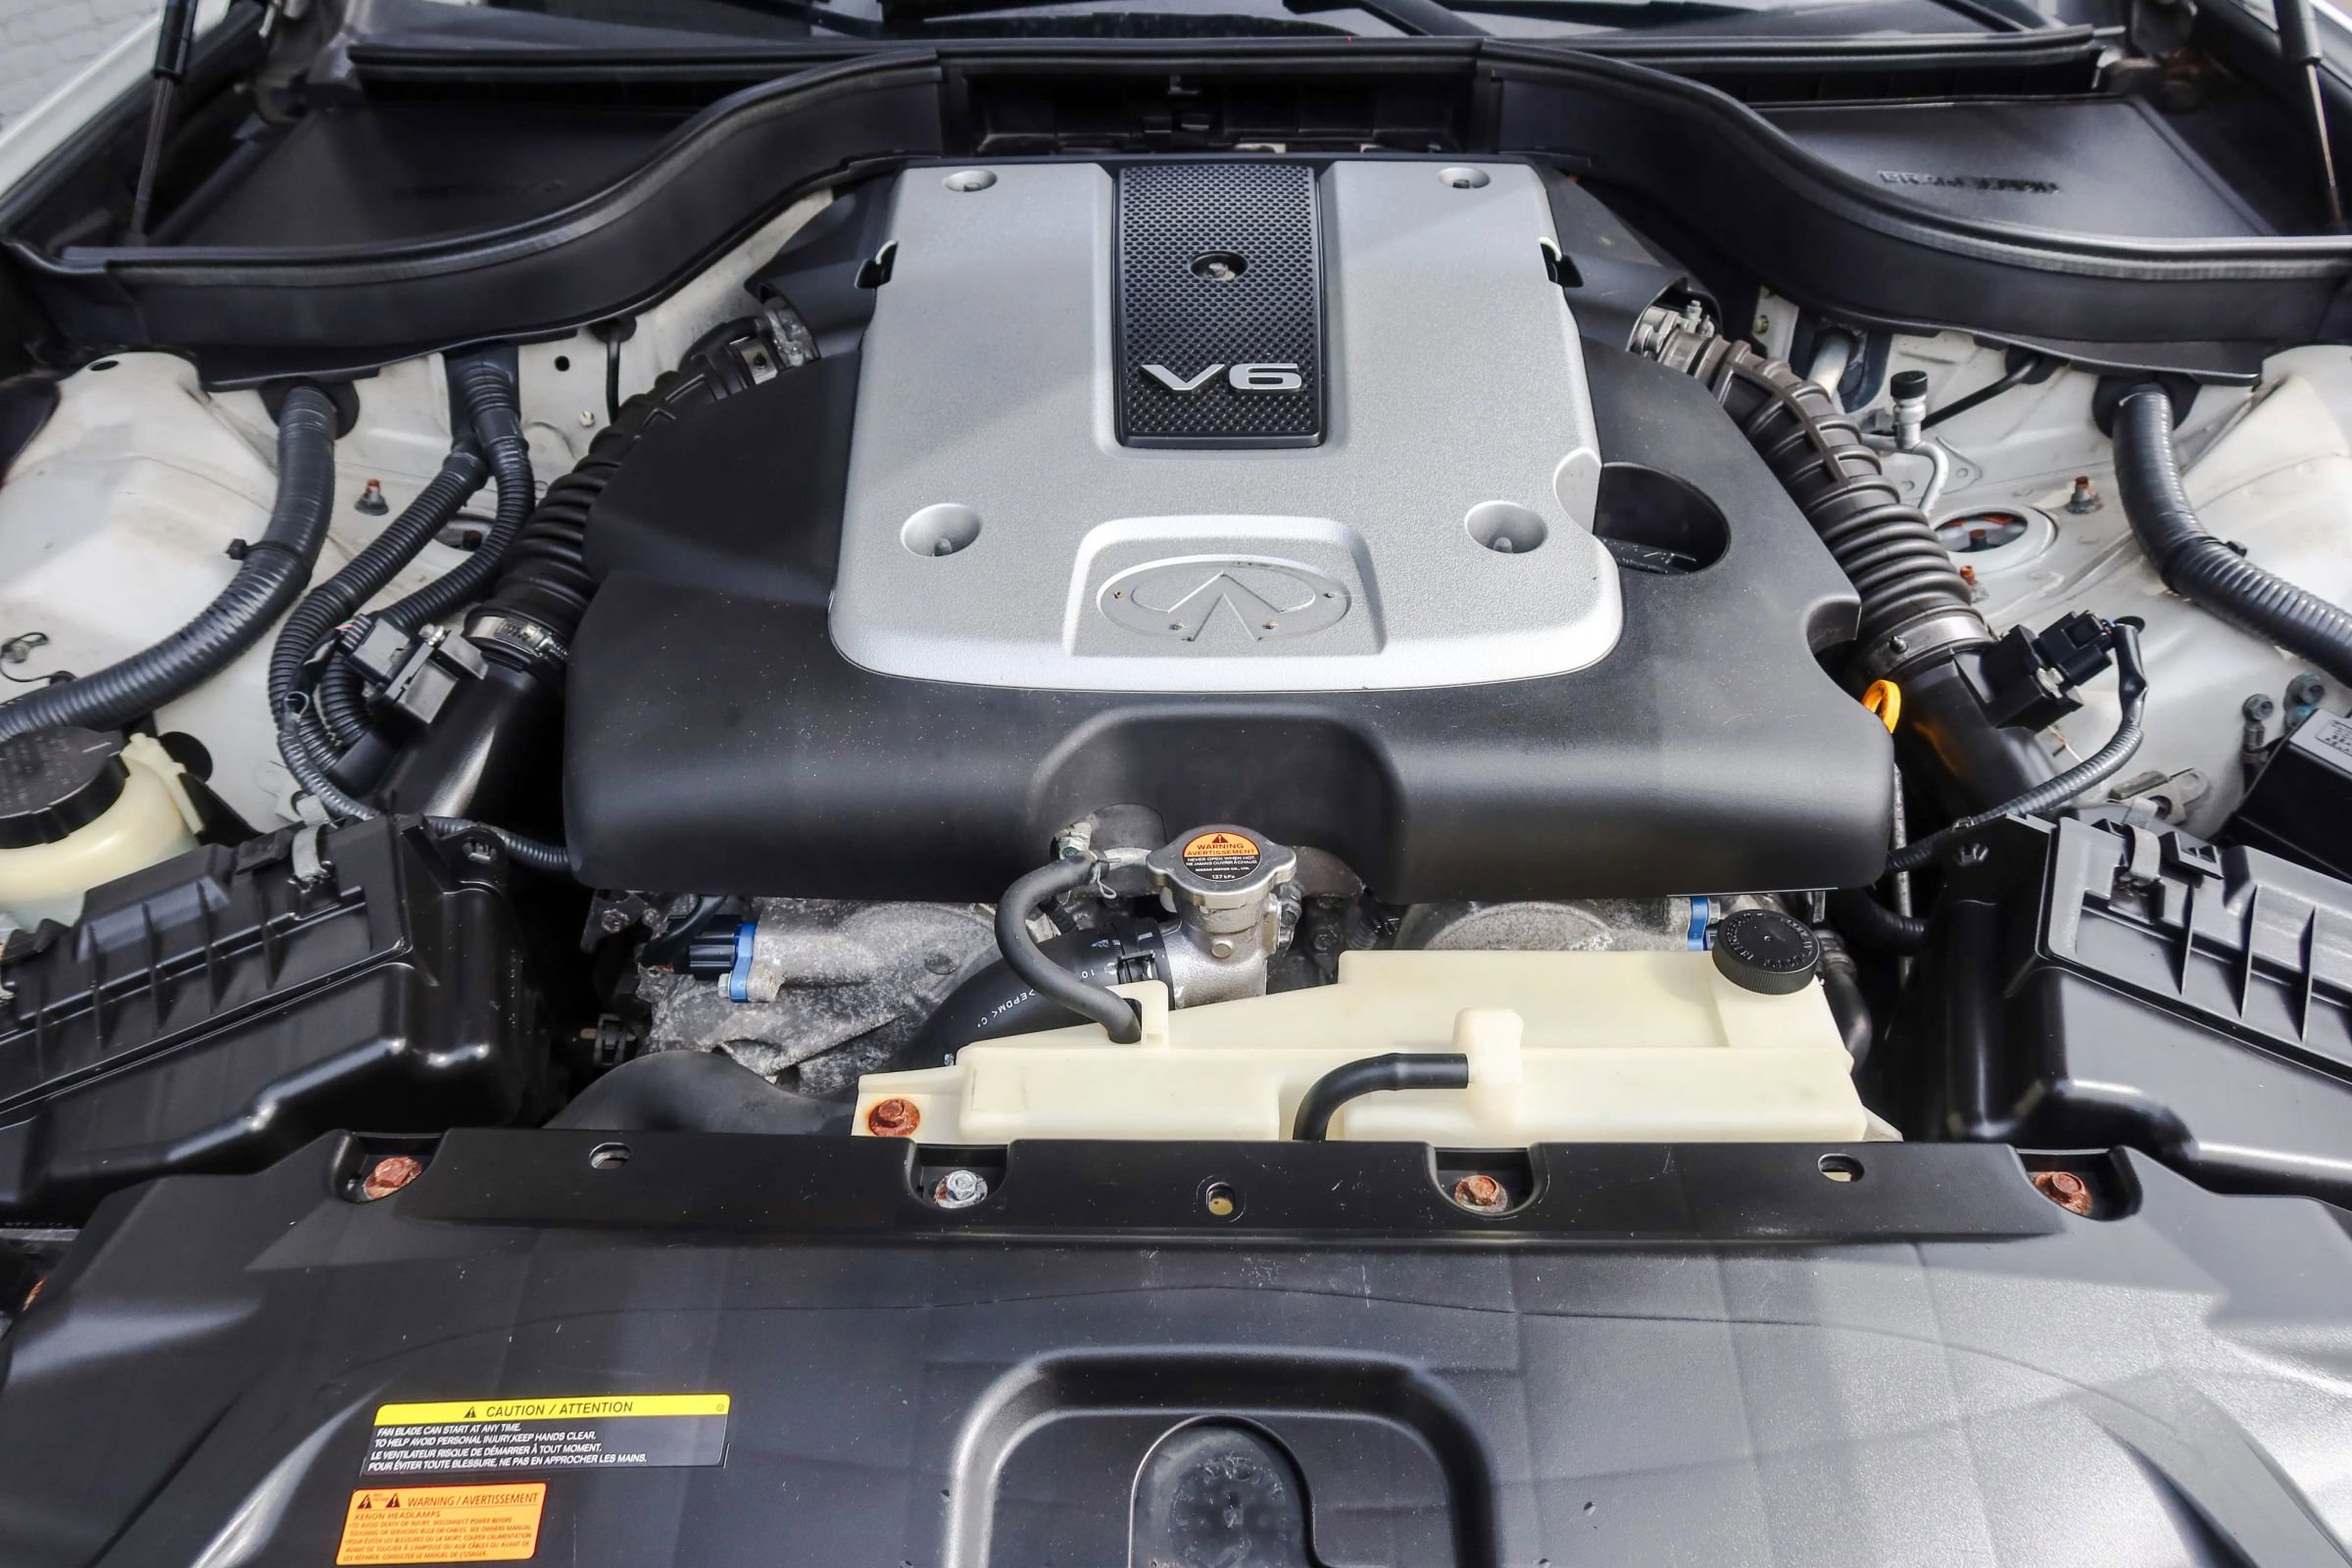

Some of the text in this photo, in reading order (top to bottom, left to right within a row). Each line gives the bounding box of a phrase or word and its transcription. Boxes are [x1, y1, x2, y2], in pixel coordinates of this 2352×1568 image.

[1140, 363, 1302, 391] V6
[486, 1404, 545, 1417] CAUTION
[560, 1402, 633, 1415] ATTENTION
[377, 1428, 393, 1437] FAN
[395, 1426, 422, 1436] BLADE
[423, 1426, 441, 1435] CAN
[443, 1425, 469, 1435] START
[470, 1424, 480, 1433] AT
[481, 1424, 500, 1433] ANY
[374, 1439, 386, 1448] TO
[387, 1438, 409, 1447] HELP
[410, 1437, 436, 1446] AVOID
[437, 1435, 481, 1445] PERSONAL
[535, 1432, 565, 1442] HANDS
[566, 1431, 596, 1440] CLEAR.
[370, 1443, 602, 1460] LE VENTILATEUR RISQUE DE DÉMARRER À TOUT MOMENT.
[368, 1453, 647, 1471] POUR ÉVITER TOUTE BLESSURE, NE PAS EN APPROCHER LES MAINS.
[408, 1496, 455, 1506] WARNING
[462, 1493, 538, 1505] AVERTISSEMENT
[354, 1512, 386, 1521] XENON
